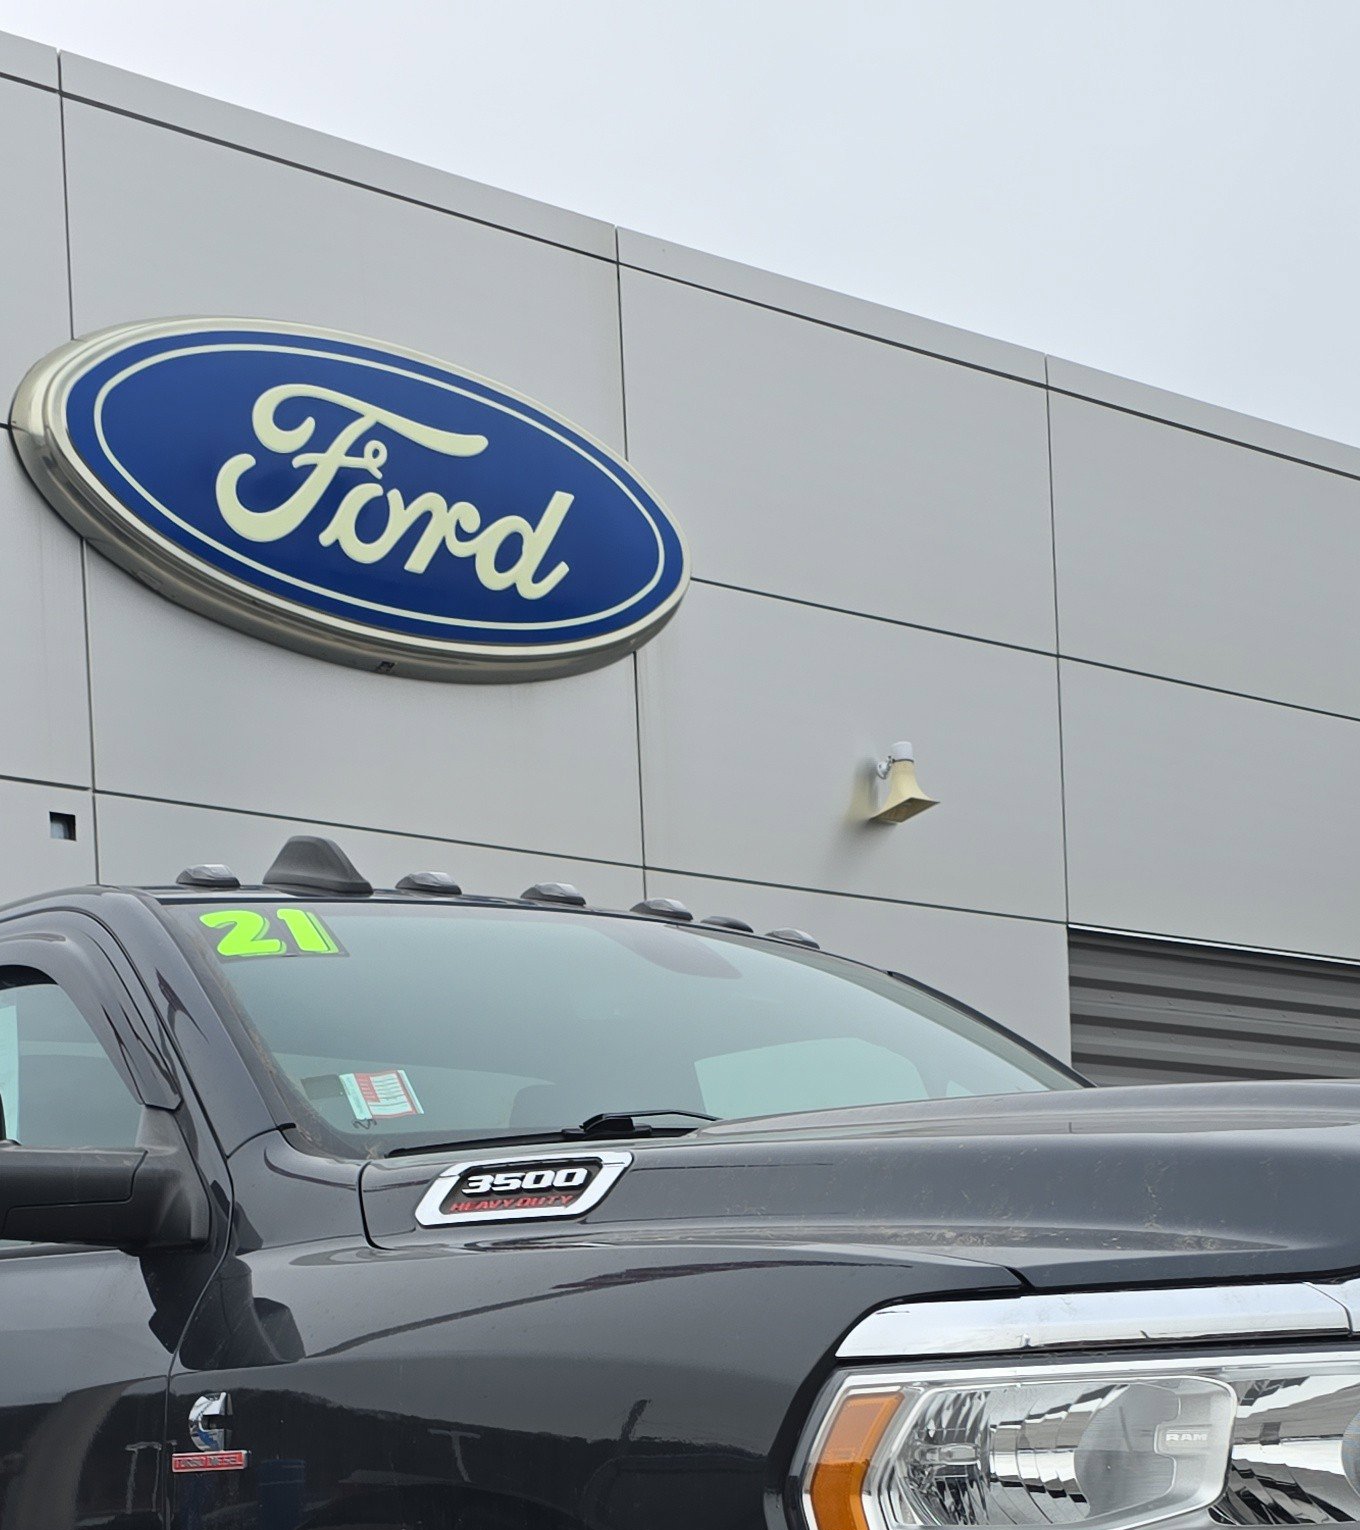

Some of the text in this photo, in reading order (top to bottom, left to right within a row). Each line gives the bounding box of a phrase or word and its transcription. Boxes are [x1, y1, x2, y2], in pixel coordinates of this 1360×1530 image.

[215, 383, 570, 600] Ford
[199, 908, 340, 958] 21
[461, 1167, 589, 1196] 3500
[449, 1194, 575, 1213] HEAVY DUTY
[1165, 1433, 1208, 1442] RAM
